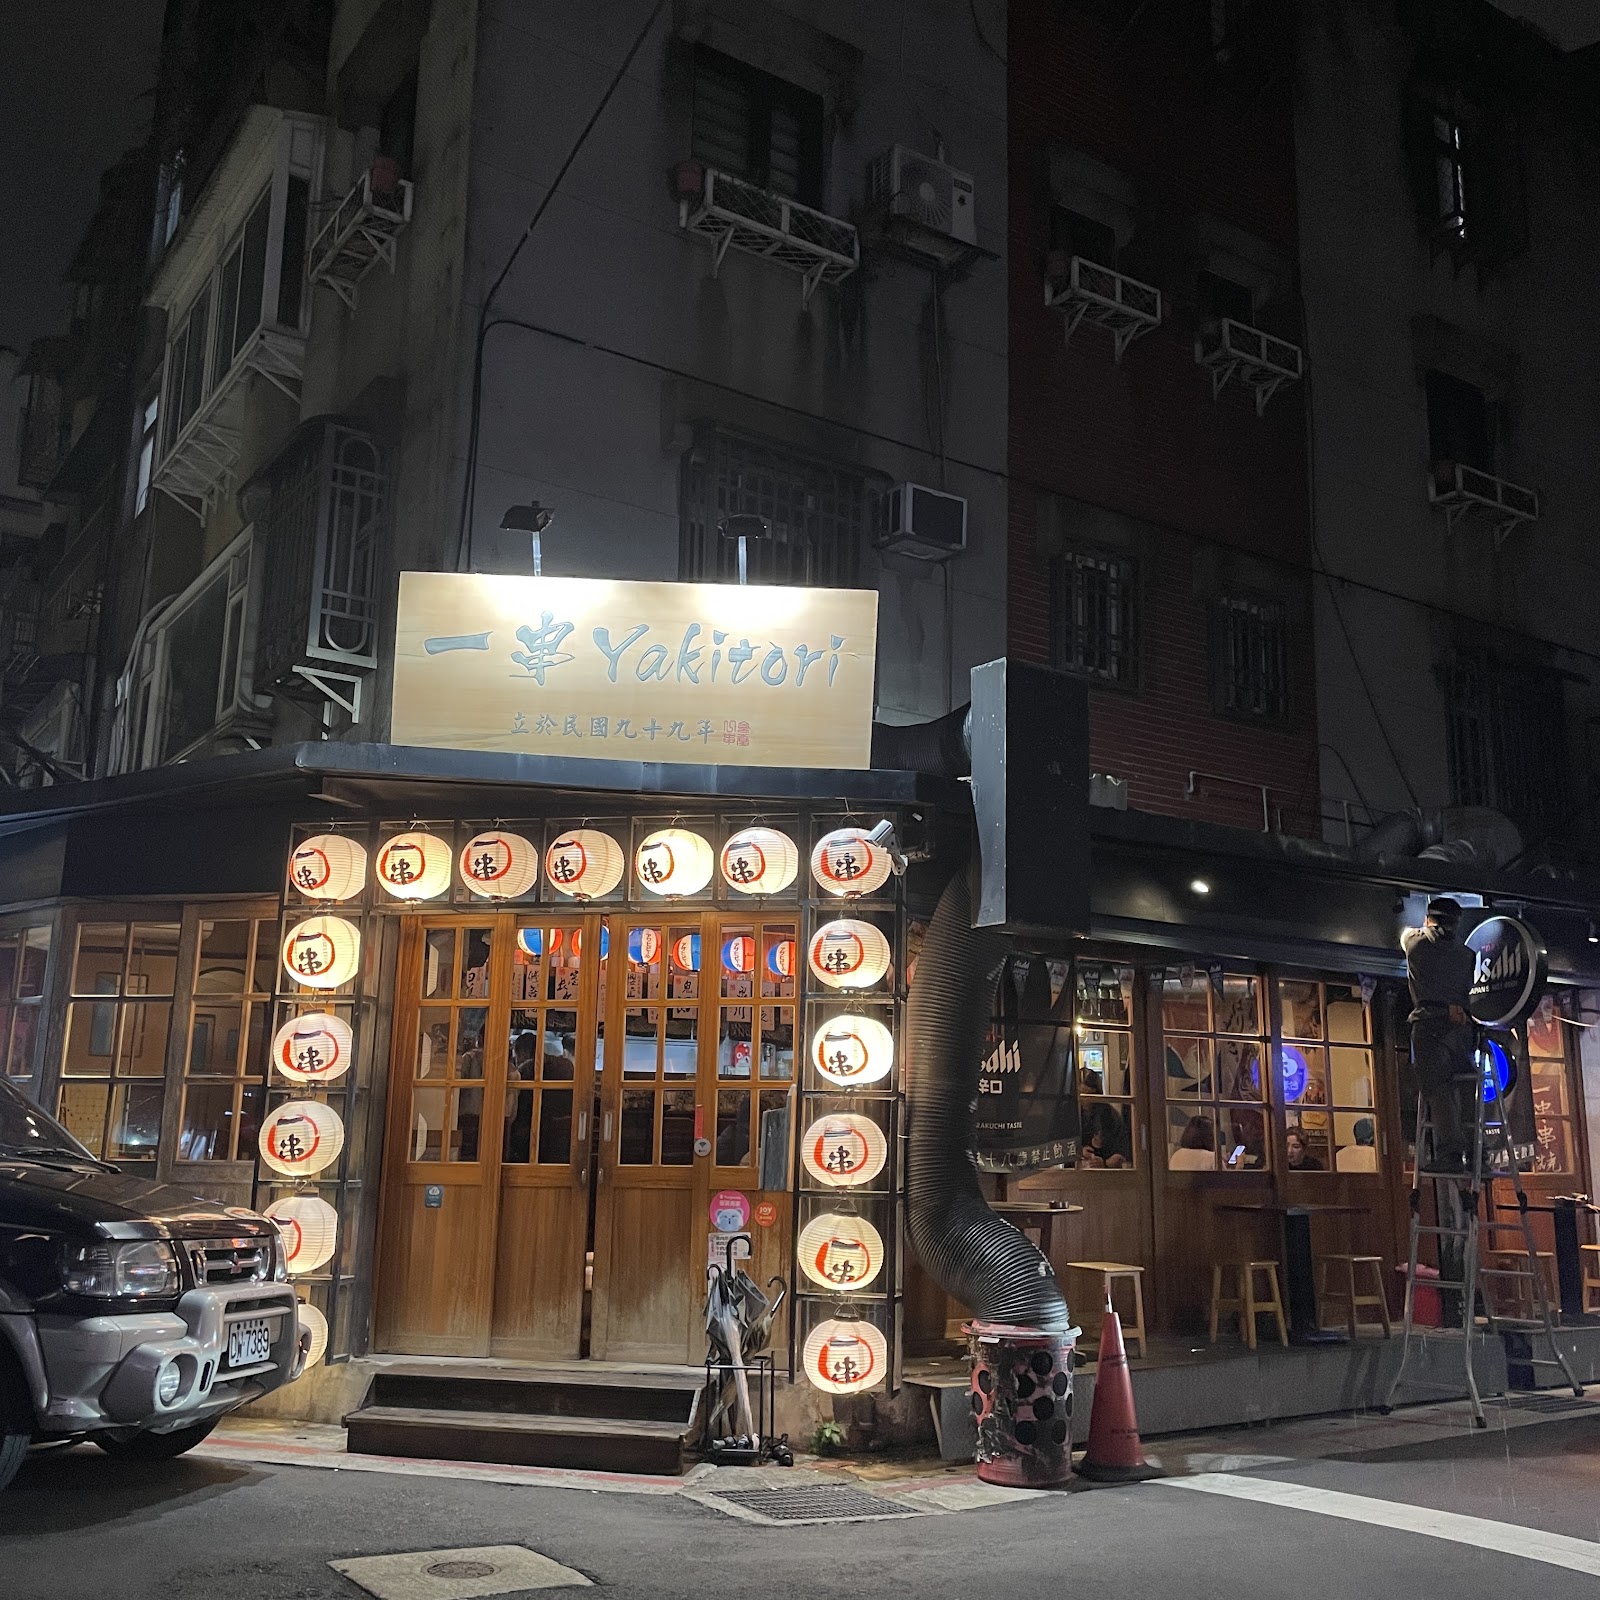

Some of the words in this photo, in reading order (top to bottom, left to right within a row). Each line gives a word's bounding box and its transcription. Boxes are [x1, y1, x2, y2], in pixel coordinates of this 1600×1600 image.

[424, 609, 577, 686] 一串
[592, 622, 848, 688] Yakitori
[510, 711, 715, 745] 立於民國九十九年
[296, 851, 317, 890] 一串
[390, 844, 416, 885] 一串
[473, 839, 499, 880] 一串
[553, 840, 575, 881] 一串
[641, 842, 663, 883] 一串
[729, 841, 754, 883] 一串
[829, 838, 860, 881] 一串
[296, 933, 323, 974] 一串
[825, 934, 853, 975] 一串
[292, 1030, 322, 1073] 一串
[824, 1033, 853, 1077] 一串
[277, 1115, 305, 1162] 一串
[823, 1129, 854, 1175] 一串
[759, 1206, 773, 1215] JOY
[828, 1239, 861, 1285] 一串
[829, 1338, 860, 1384] 一串
